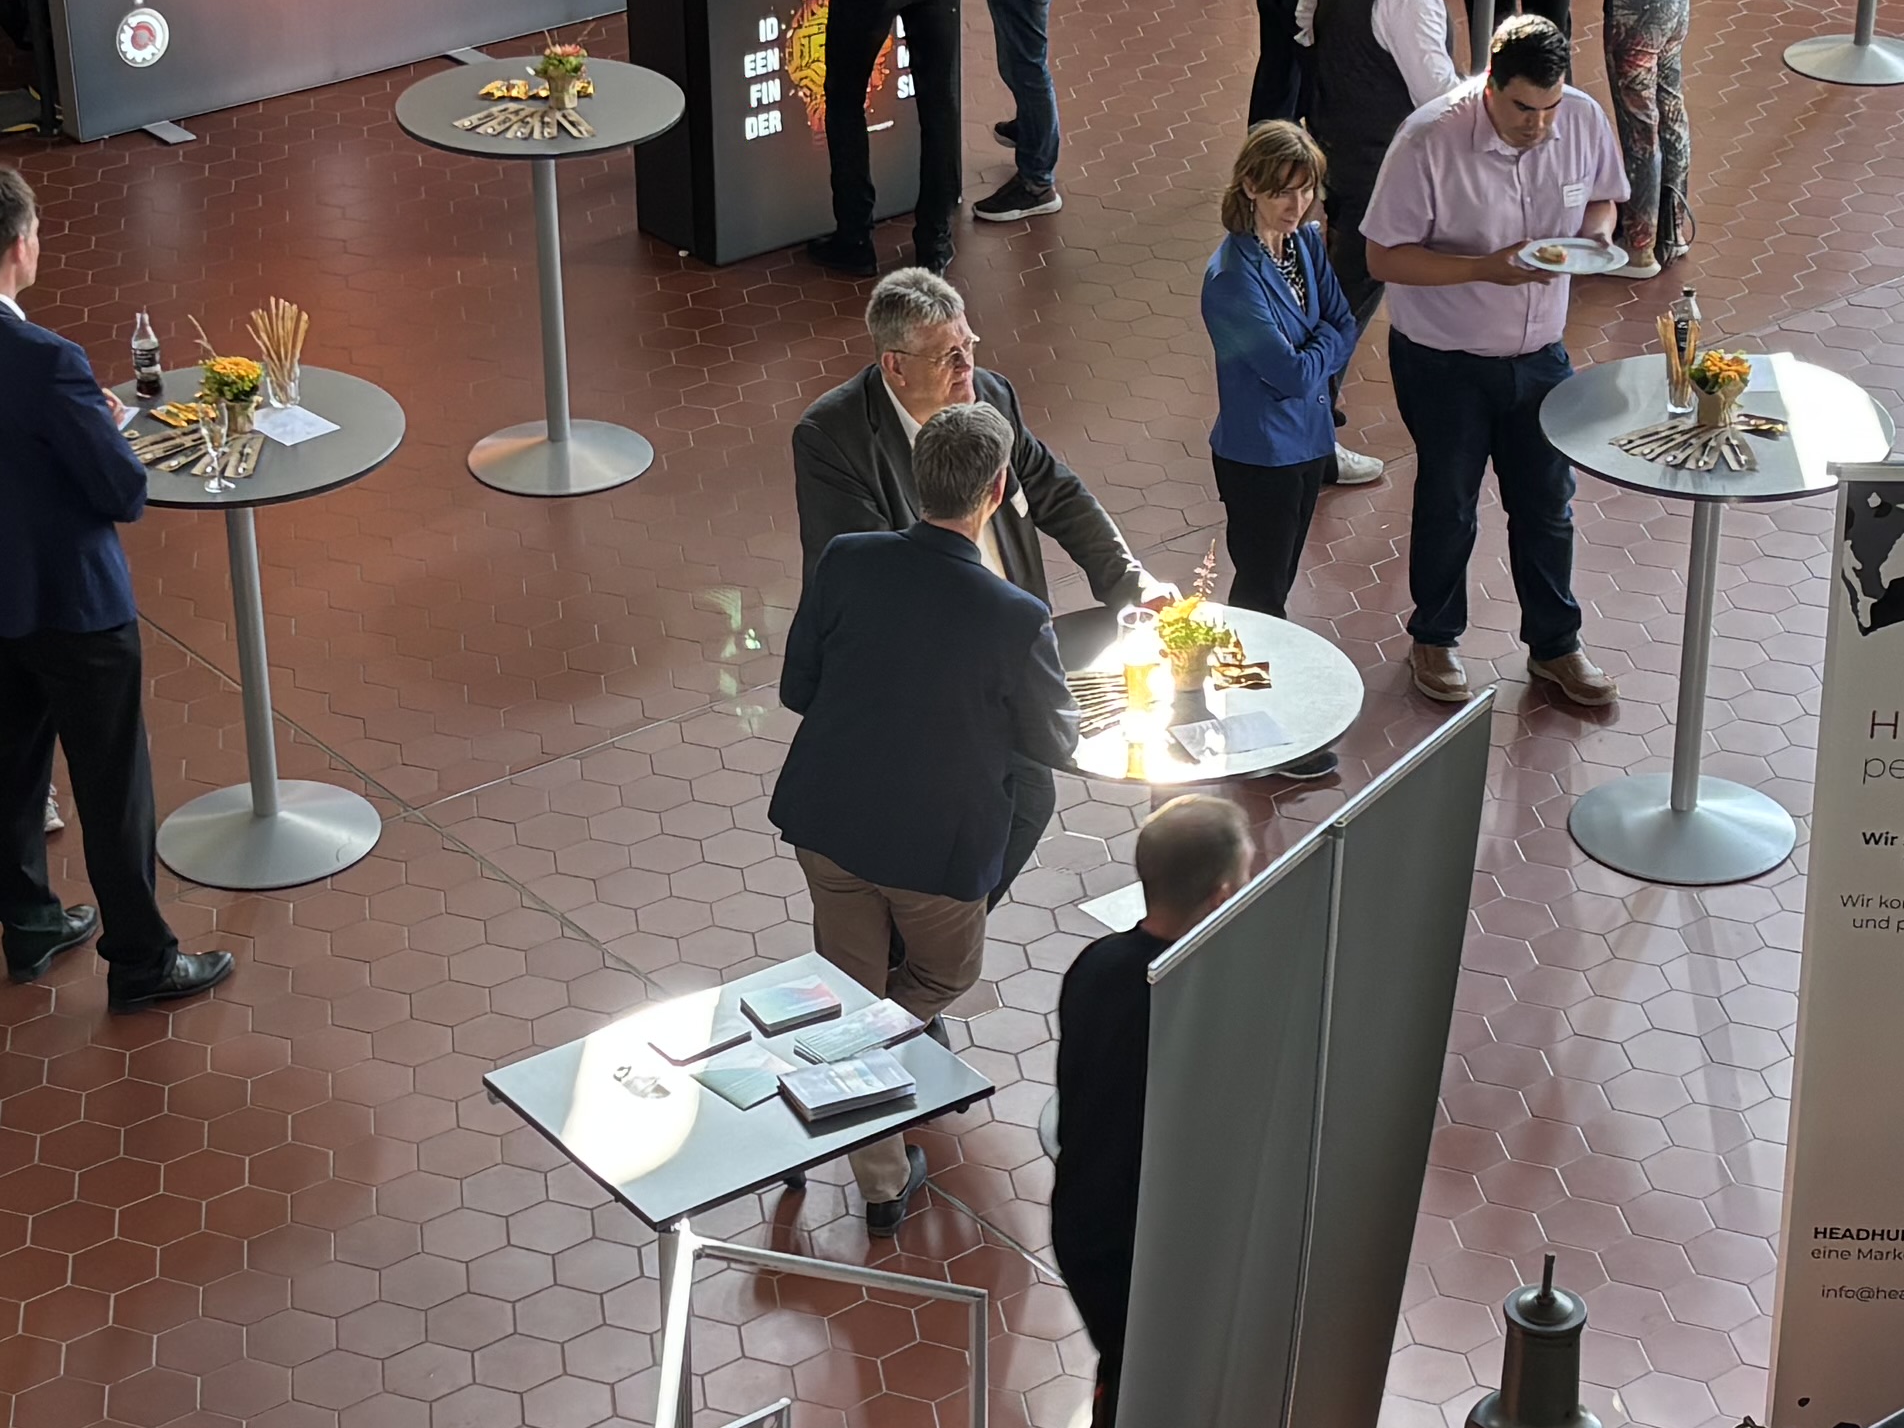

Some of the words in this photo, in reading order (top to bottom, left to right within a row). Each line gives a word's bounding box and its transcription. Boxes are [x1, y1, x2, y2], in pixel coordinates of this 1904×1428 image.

[758, 16, 779, 43] ID
[744, 47, 780, 78] EEN
[749, 79, 781, 108] FIN
[744, 110, 782, 141] DER
[1862, 831, 1897, 848] Wir
[1840, 894, 1873, 909] Wir
[1852, 915, 1891, 930] und
[1811, 1248, 1852, 1260] eine
